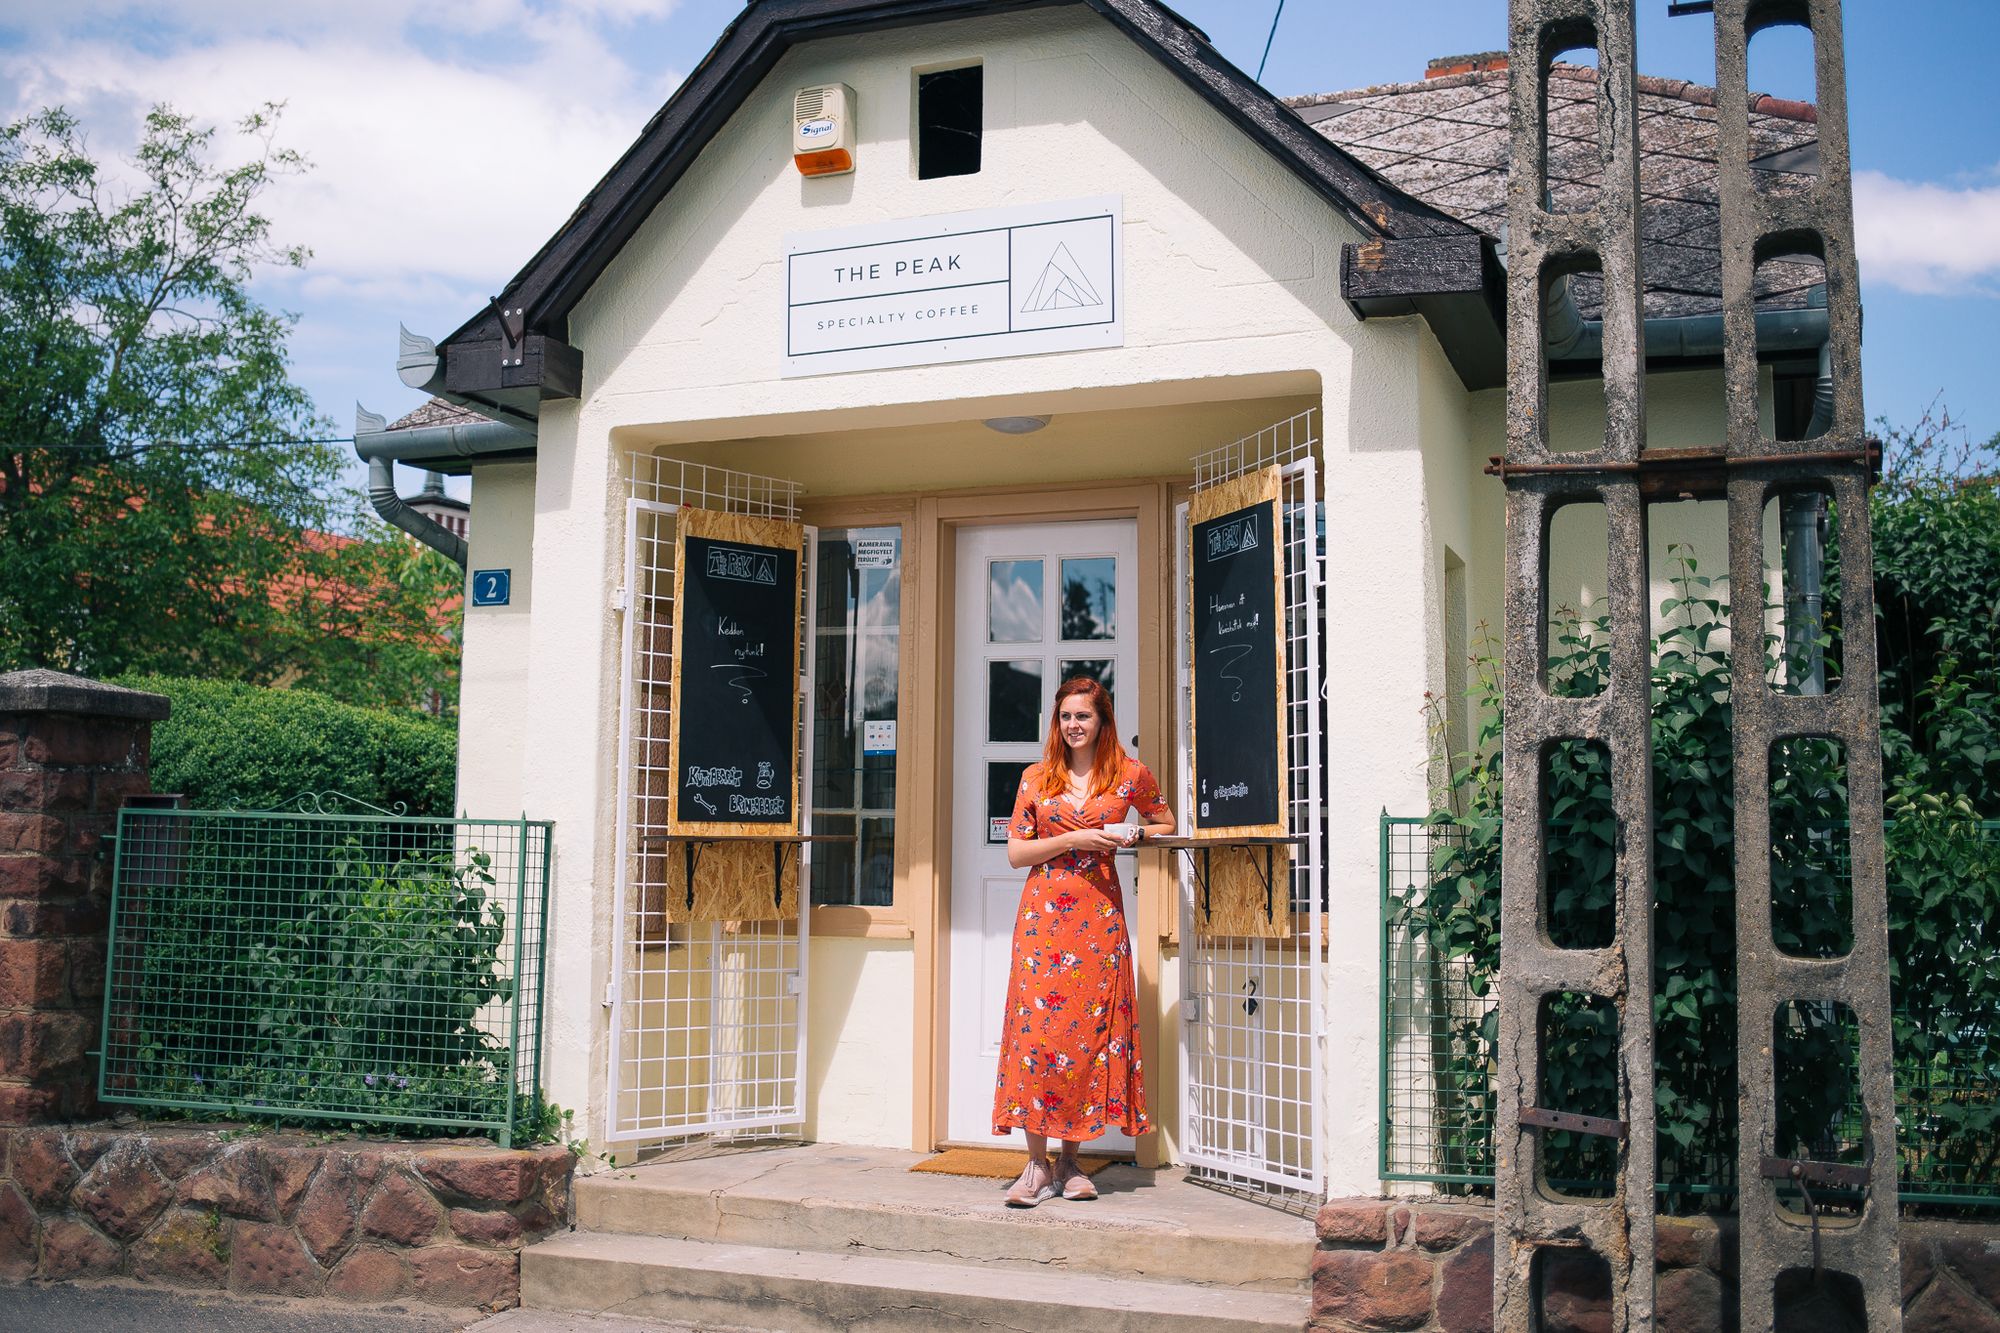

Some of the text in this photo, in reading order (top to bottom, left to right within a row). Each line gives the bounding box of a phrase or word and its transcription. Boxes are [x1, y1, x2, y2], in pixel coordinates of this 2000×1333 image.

[802, 123, 832, 136] Signal
[834, 254, 962, 284] THE PEAK
[817, 303, 980, 331] SPECIALTY COFFEE
[486, 576, 497, 598] 2
